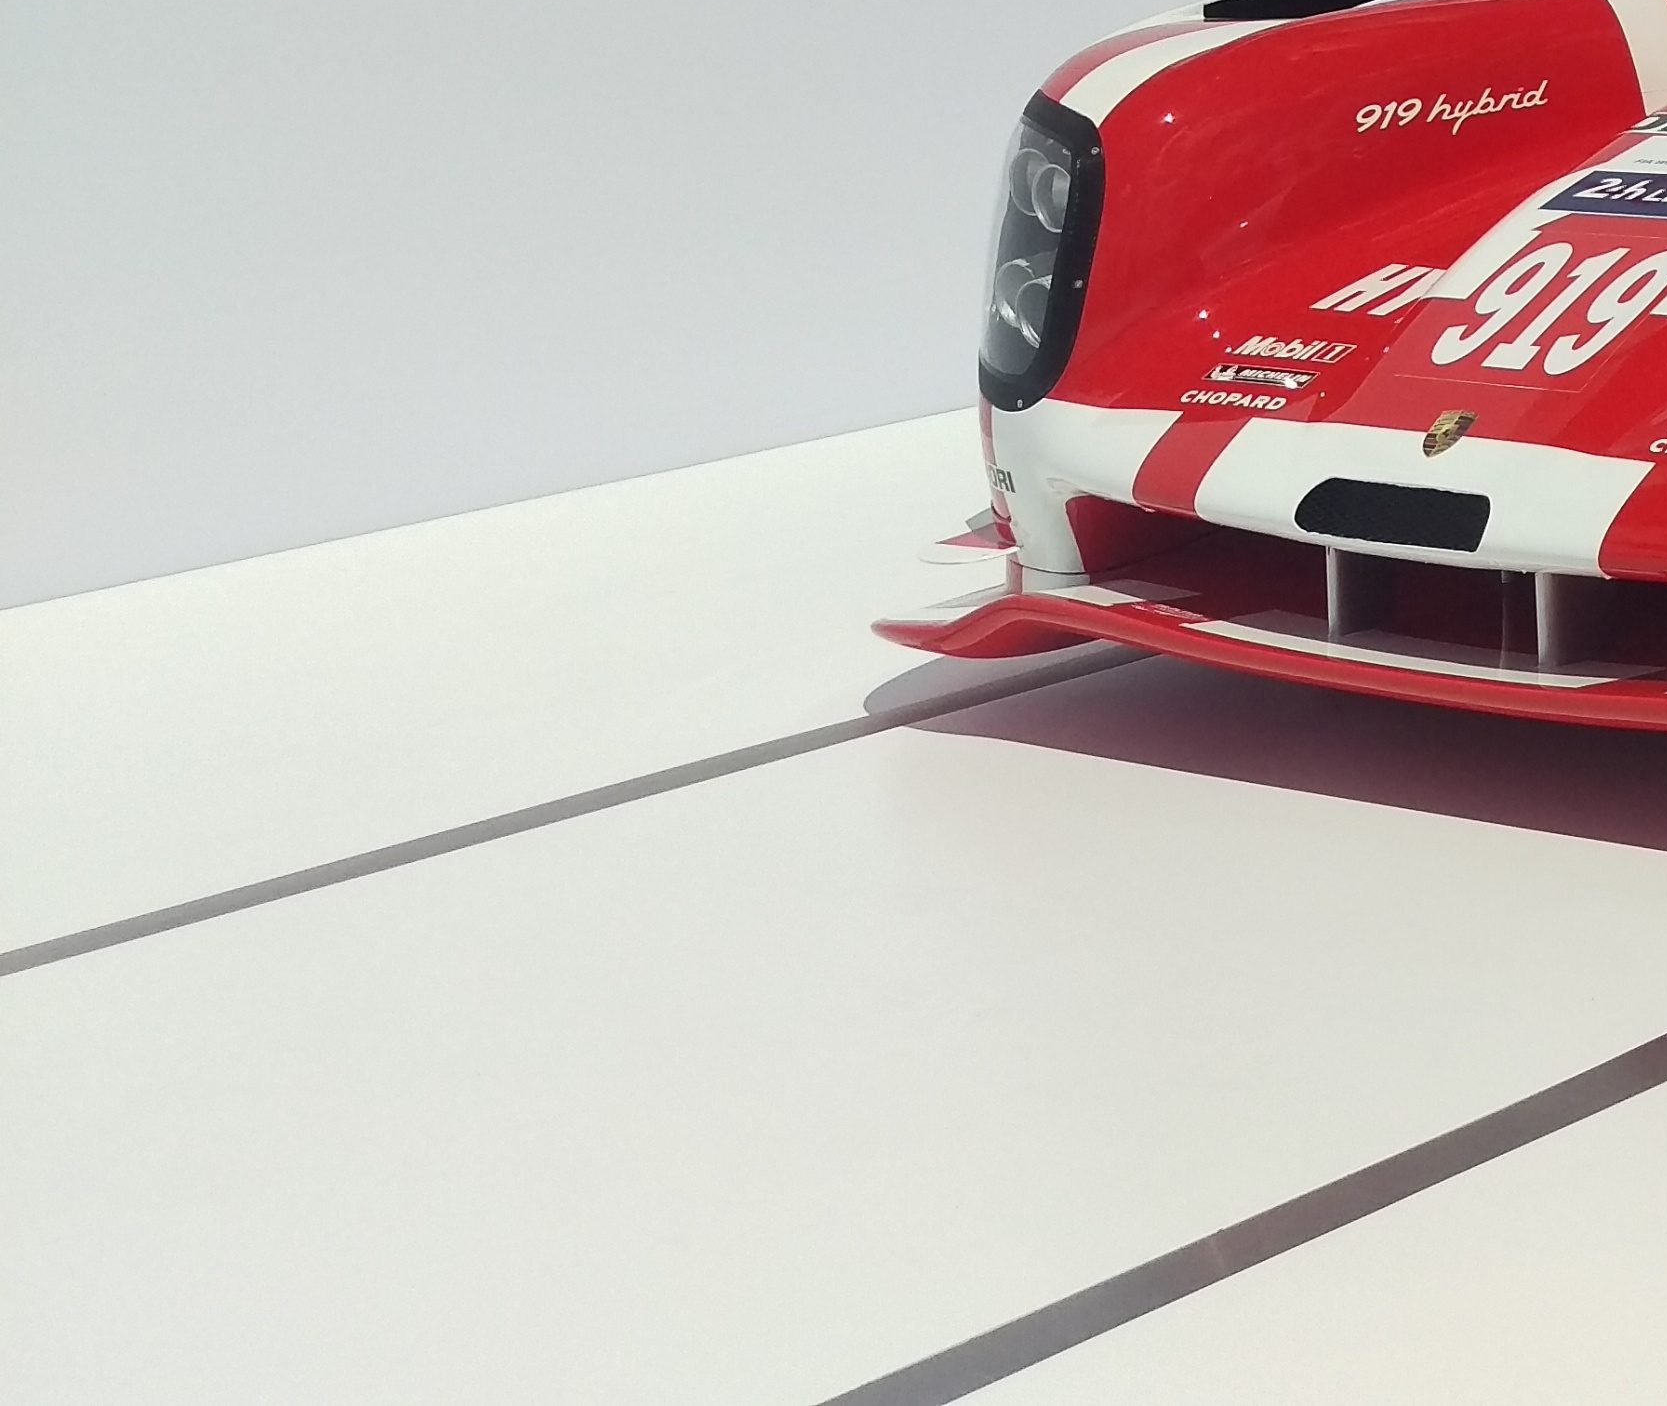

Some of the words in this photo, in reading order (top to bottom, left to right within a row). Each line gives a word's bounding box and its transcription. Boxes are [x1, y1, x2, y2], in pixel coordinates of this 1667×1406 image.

[1355, 97, 1423, 133] 919
[1426, 80, 1549, 135] hybrid
[1230, 335, 1327, 363] Mobil
[1181, 389, 1287, 411] CHOPARD
